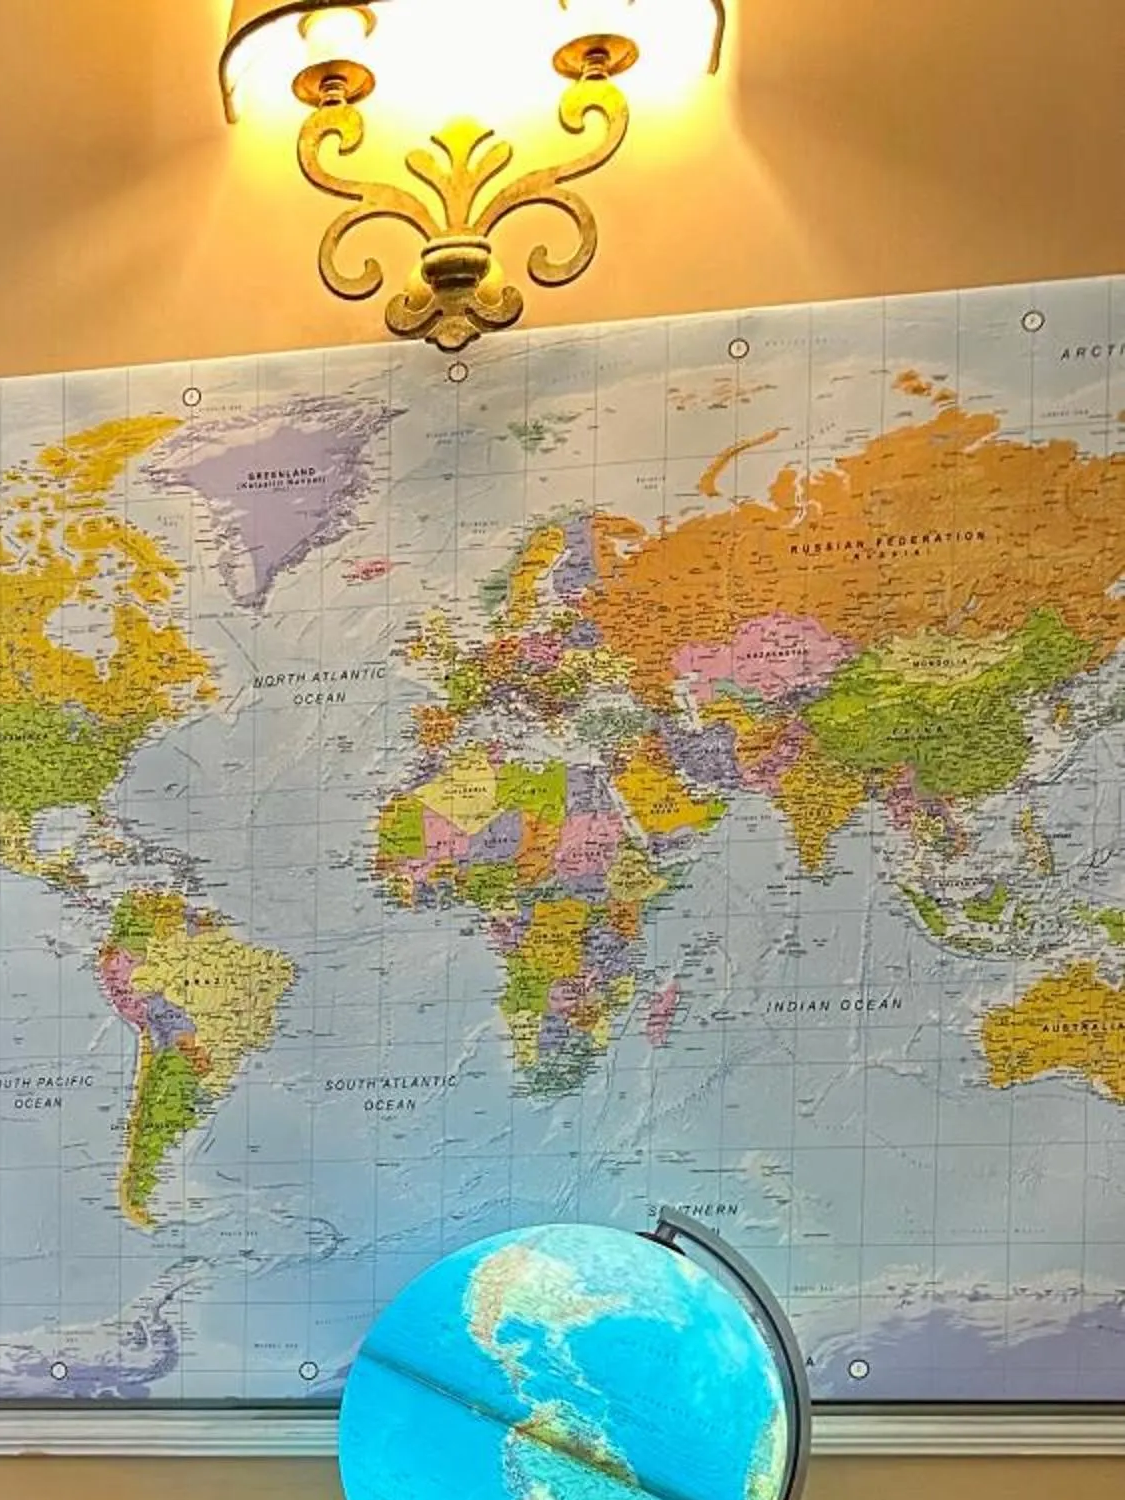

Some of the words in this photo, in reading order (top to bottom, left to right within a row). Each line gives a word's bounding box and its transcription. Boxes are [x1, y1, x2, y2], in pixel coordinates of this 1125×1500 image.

[1060, 344, 1125, 360] ARCTI
[248, 467, 316, 480] GREENLAND
[790, 540, 864, 555] RUSSIAN
[876, 532, 985, 548] FEDERATION
[253, 672, 305, 688] NORTH
[311, 667, 388, 683] ATLANTIC
[293, 692, 346, 705] OCEAN
[766, 1000, 829, 1013] INDIAN
[840, 997, 902, 1011] OCEAN
[37, 1075, 93, 1087] PACIFIC
[325, 1078, 376, 1091] SOUTH
[381, 1075, 458, 1089] ATLANTIC
[15, 1097, 62, 1109] OCEAN
[364, 1099, 416, 1111] OCEAN
[648, 1203, 738, 1217] STHERN
